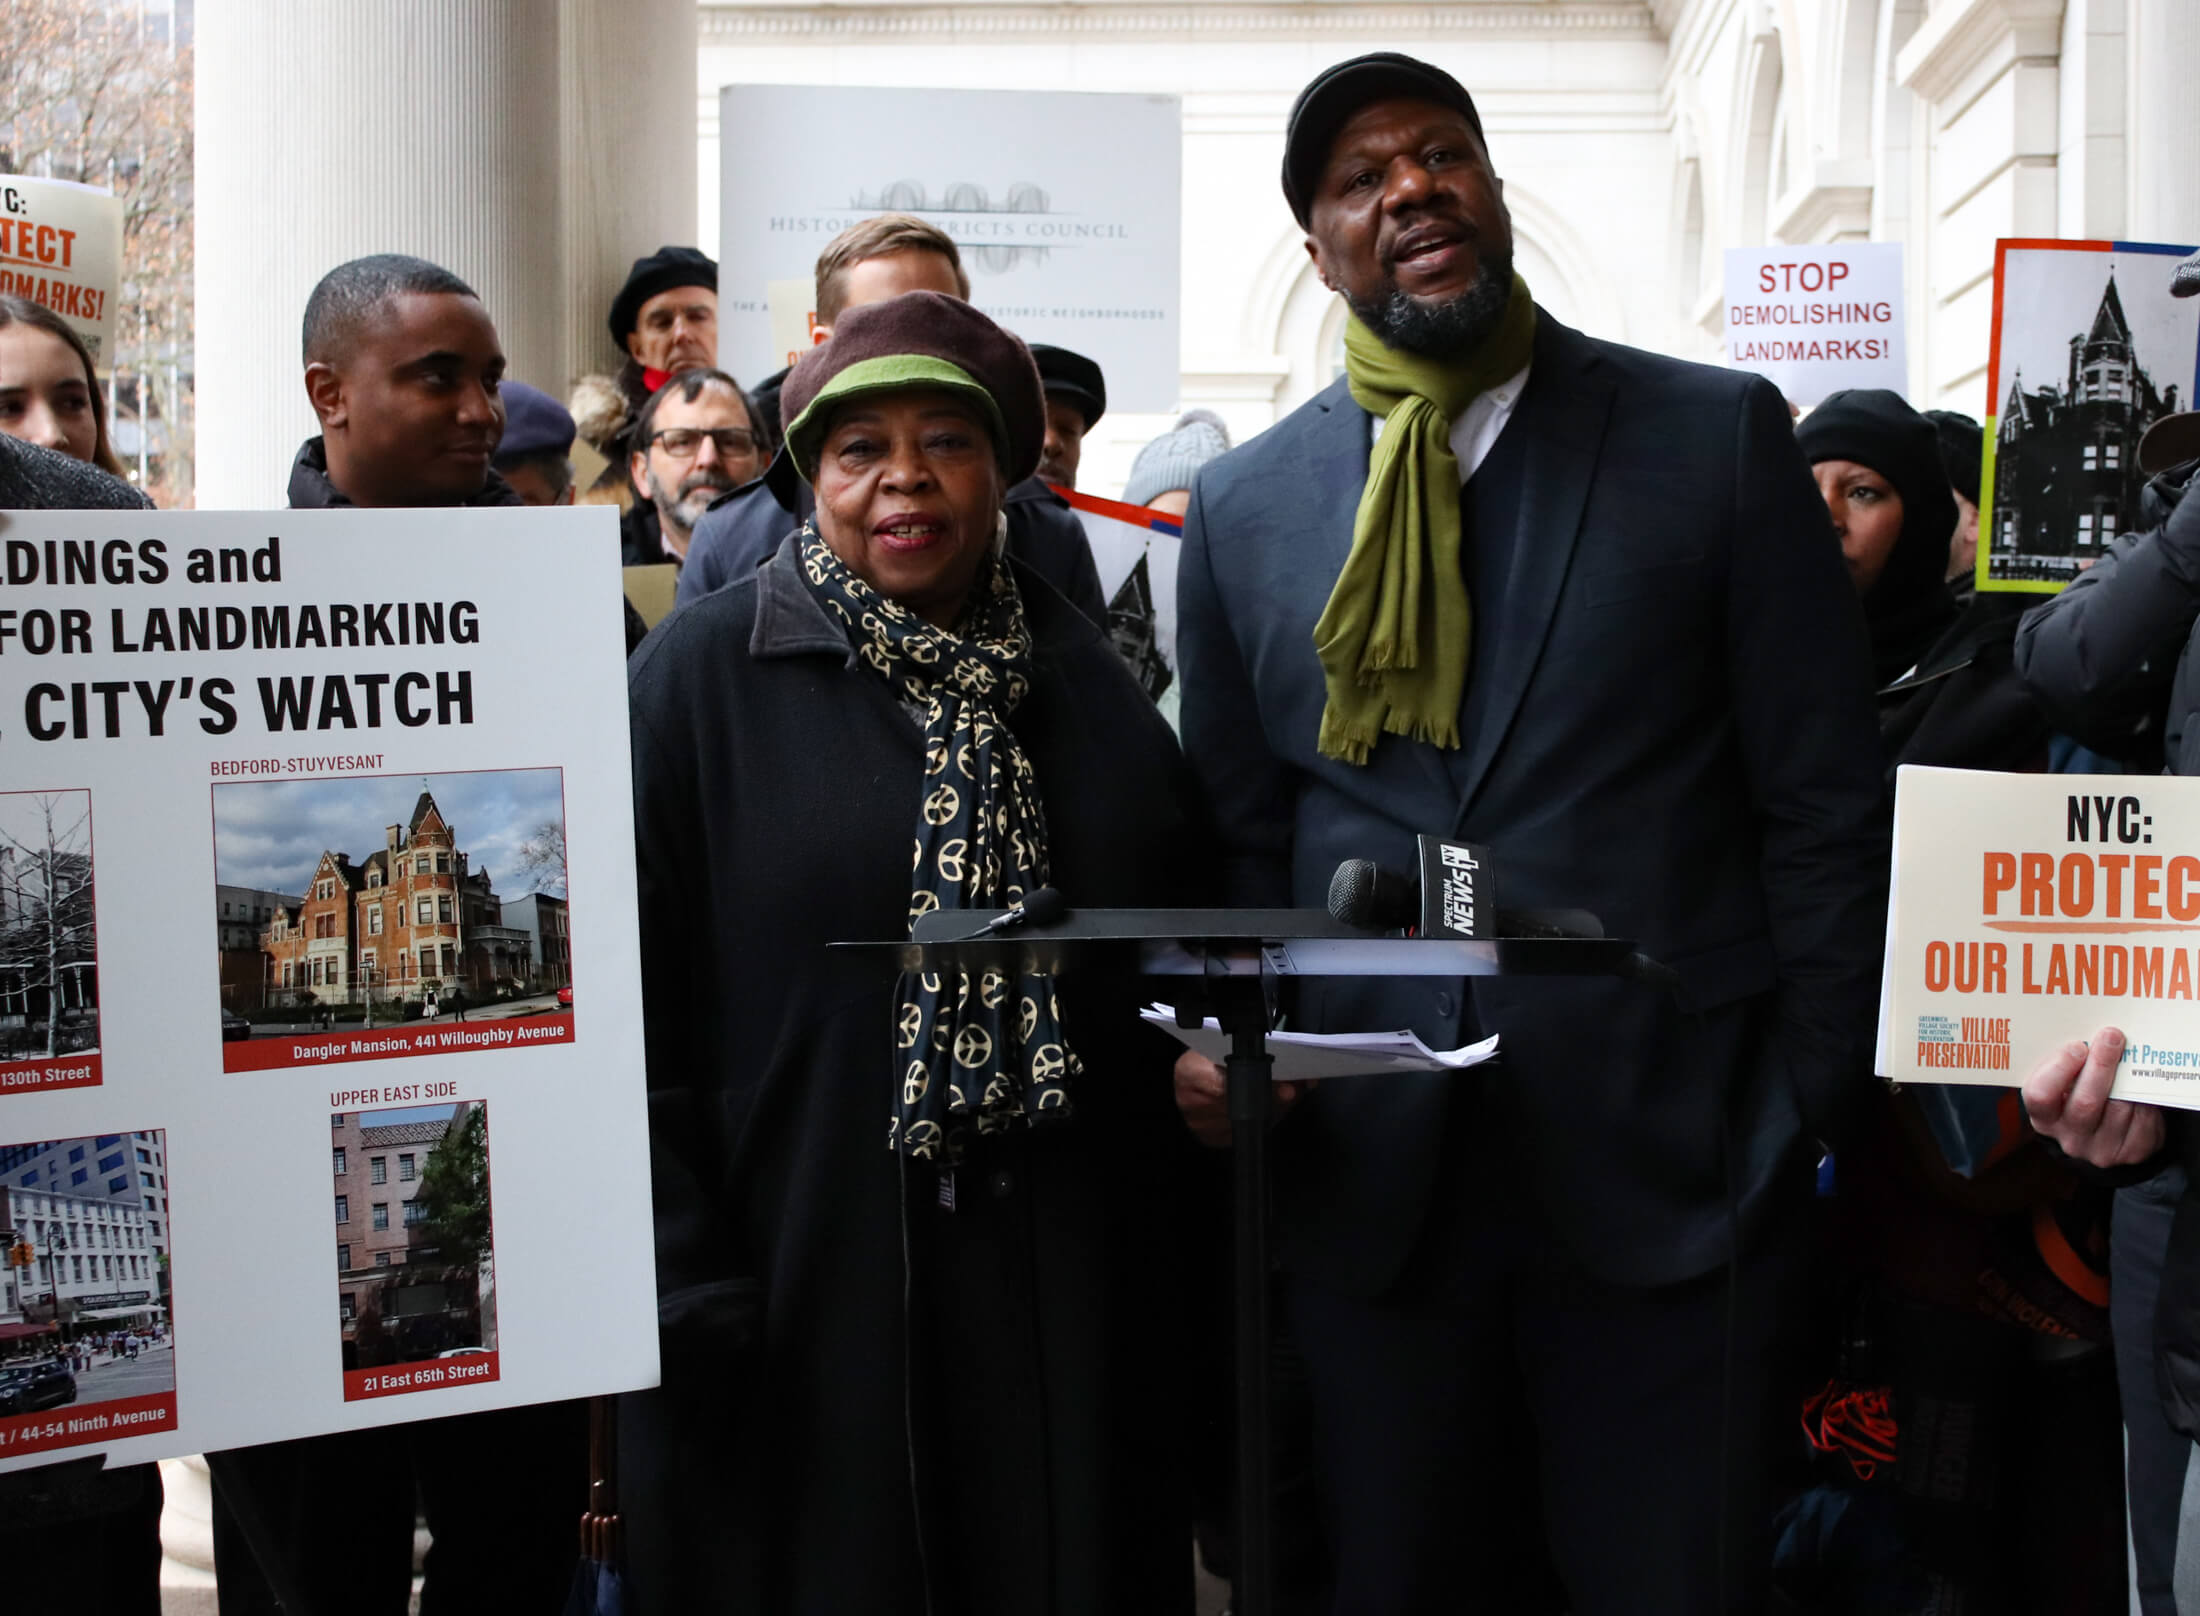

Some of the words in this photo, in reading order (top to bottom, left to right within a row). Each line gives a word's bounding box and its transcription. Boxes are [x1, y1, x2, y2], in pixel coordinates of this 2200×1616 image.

[0, 187, 27, 215] C:
[1026, 223, 1129, 239] COUNCIL
[1759, 262, 1849, 293] STOP
[733, 301, 755, 312] THE
[1731, 302, 1892, 325] DEMOLISHING
[1734, 339, 1889, 361] LANDMARKS!
[0, 539, 169, 585] DINGS
[187, 537, 282, 583] and
[0, 608, 93, 655] FOR
[111, 600, 480, 653] LANDMARKING
[25, 676, 237, 741] CITY'S
[257, 670, 474, 731] WATCH
[210, 754, 384, 776] BEDFORD-STUYVESANT
[2067, 795, 2152, 844] NYC:
[1983, 852, 2200, 922] PROTEC
[1443, 878, 1453, 929] SPECTRUM
[1452, 868, 1474, 936] NEWS
[1924, 941, 2008, 994] OUR
[2022, 943, 2200, 1001] LANDMA
[293, 1042, 347, 1060] Dangler
[351, 1037, 412, 1055] Mansion,
[415, 1034, 436, 1048] 441
[440, 1028, 514, 1046] Willoughby
[518, 1025, 565, 1040] Avenue
[1961, 1017, 2011, 1044] VILLAGE
[1917, 1041, 2010, 1070] PRESERVATION
[2142, 1045, 2200, 1067] Preserv
[1, 1069, 41, 1086] 130th
[45, 1065, 91, 1082] Street
[331, 1088, 378, 1107] UPPER
[384, 1084, 420, 1102] EAST
[424, 1081, 457, 1099] SIDE
[364, 1377, 377, 1391] 21
[382, 1373, 411, 1388] East
[415, 1368, 444, 1384] 65th
[448, 1362, 489, 1379] Street
[21, 1421, 65, 1441] 44-54
[68, 1415, 109, 1433] Ninth
[112, 1407, 166, 1427] Avenue
